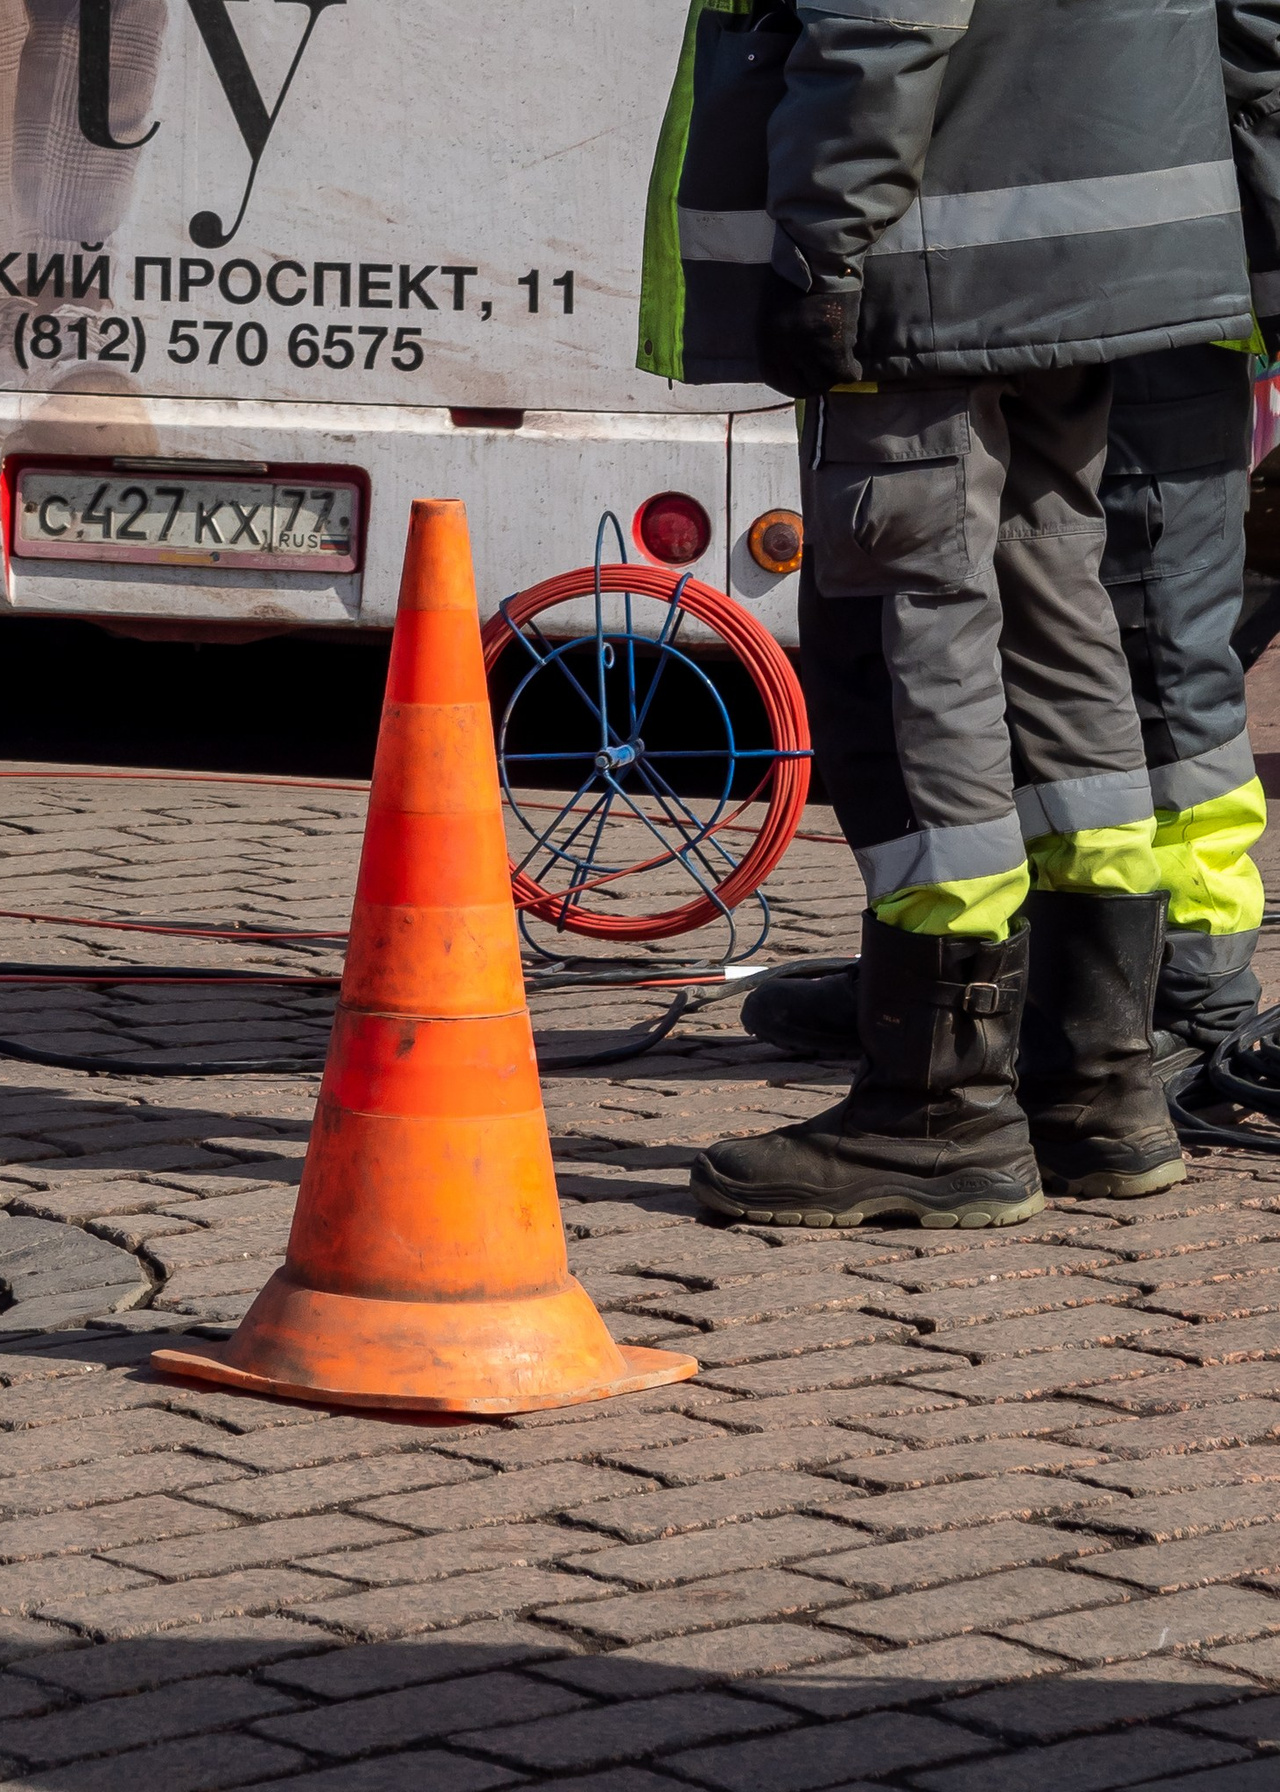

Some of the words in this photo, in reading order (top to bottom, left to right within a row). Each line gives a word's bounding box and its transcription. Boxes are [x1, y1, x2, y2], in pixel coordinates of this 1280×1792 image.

[135, 256, 493, 322] ПРОСПЕКТ,
[517, 269, 576, 315] 11
[14, 313, 146, 372] (812)
[167, 318, 269, 367] 570
[287, 323, 424, 372] 6575
[278, 533, 319, 549] RUS
